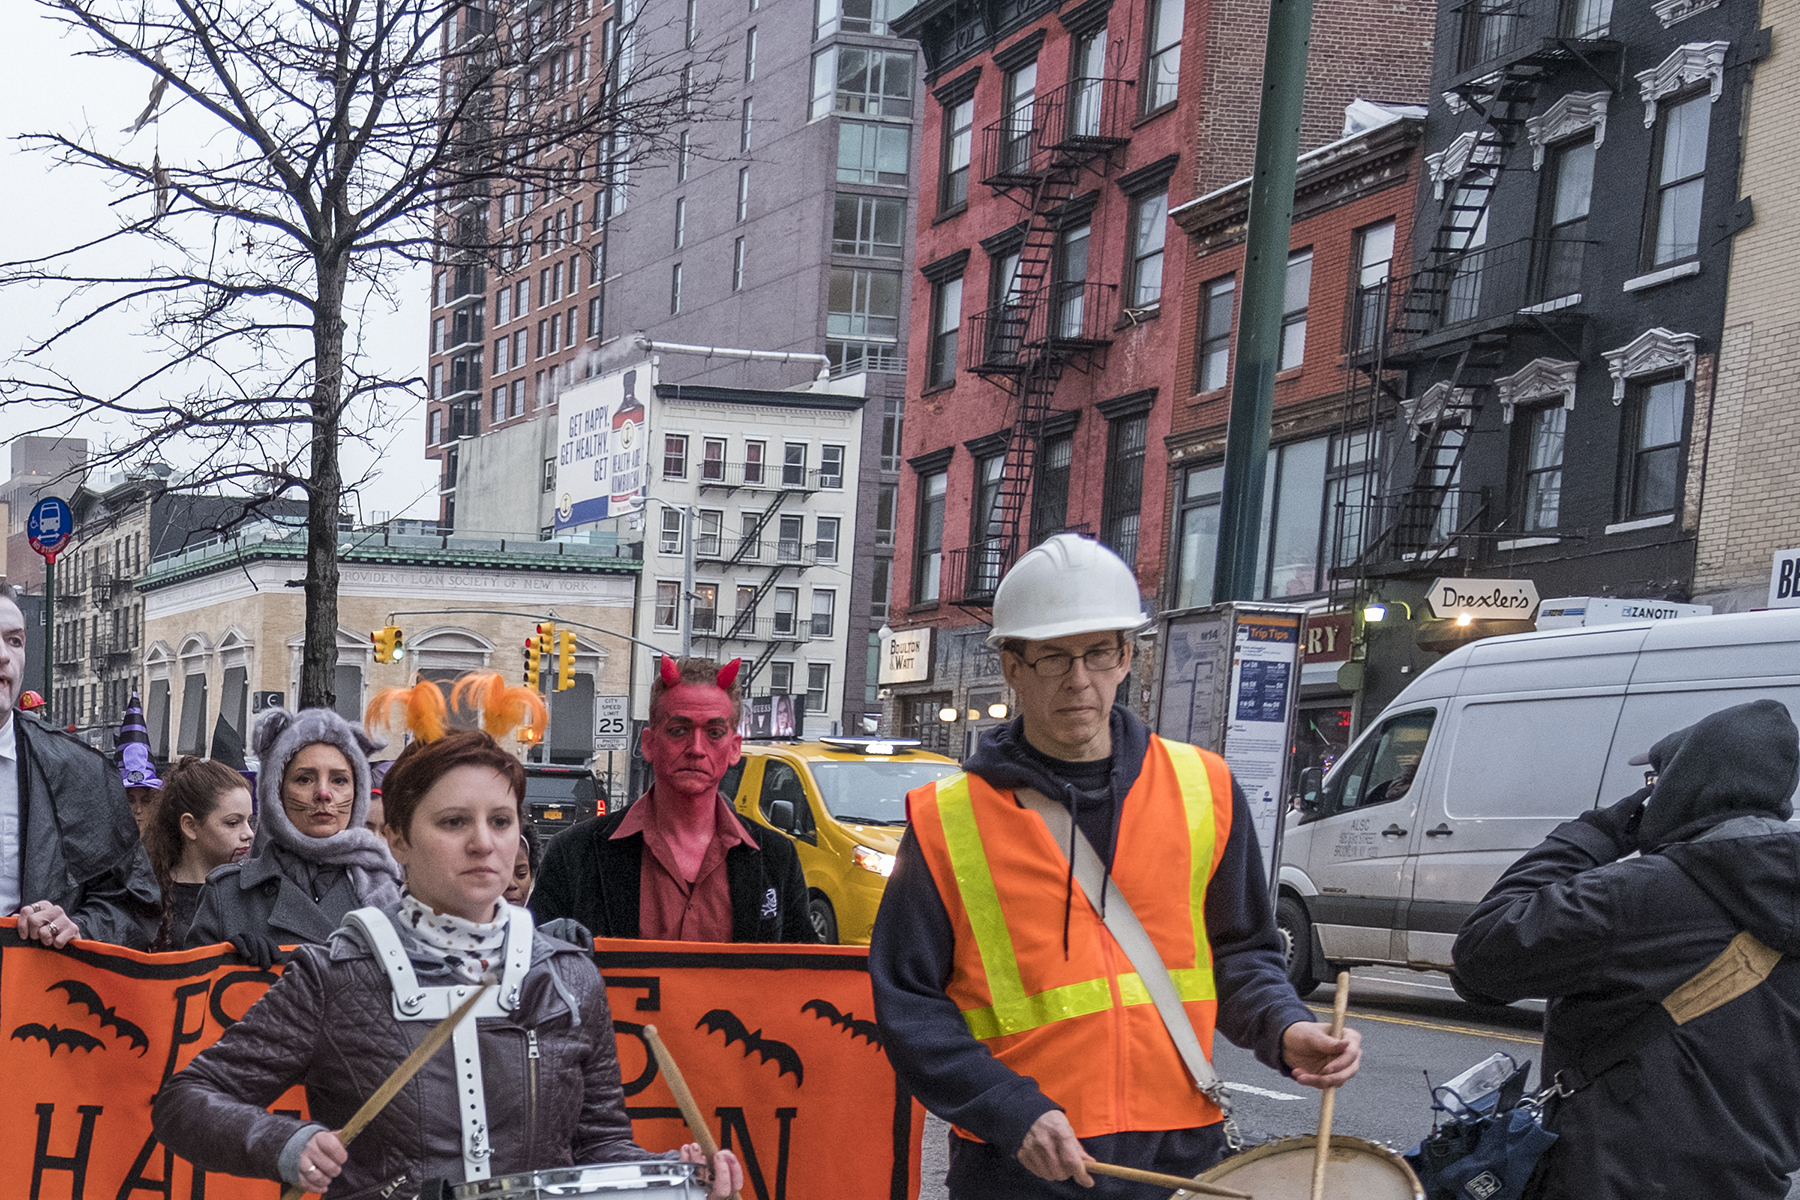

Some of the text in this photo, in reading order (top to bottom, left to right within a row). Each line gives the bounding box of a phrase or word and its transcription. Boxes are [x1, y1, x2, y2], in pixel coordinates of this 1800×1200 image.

[569, 405, 610, 438] GET HAPPY.
[561, 431, 608, 466] GET HEALTHY.
[594, 457, 608, 481] GET
[339, 571, 589, 591] PROVIDENT LOAN SOCIETY OF NEW YORK
[1442, 587, 1529, 608] Drexler's
[1631, 607, 1678, 619] ZANOTTI
[1250, 628, 1289, 640] Trip Tips
[1307, 626, 1339, 654] RY
[890, 639, 921, 655] BOULTON
[895, 655, 914, 670] WATT
[599, 718, 624, 733] 25
